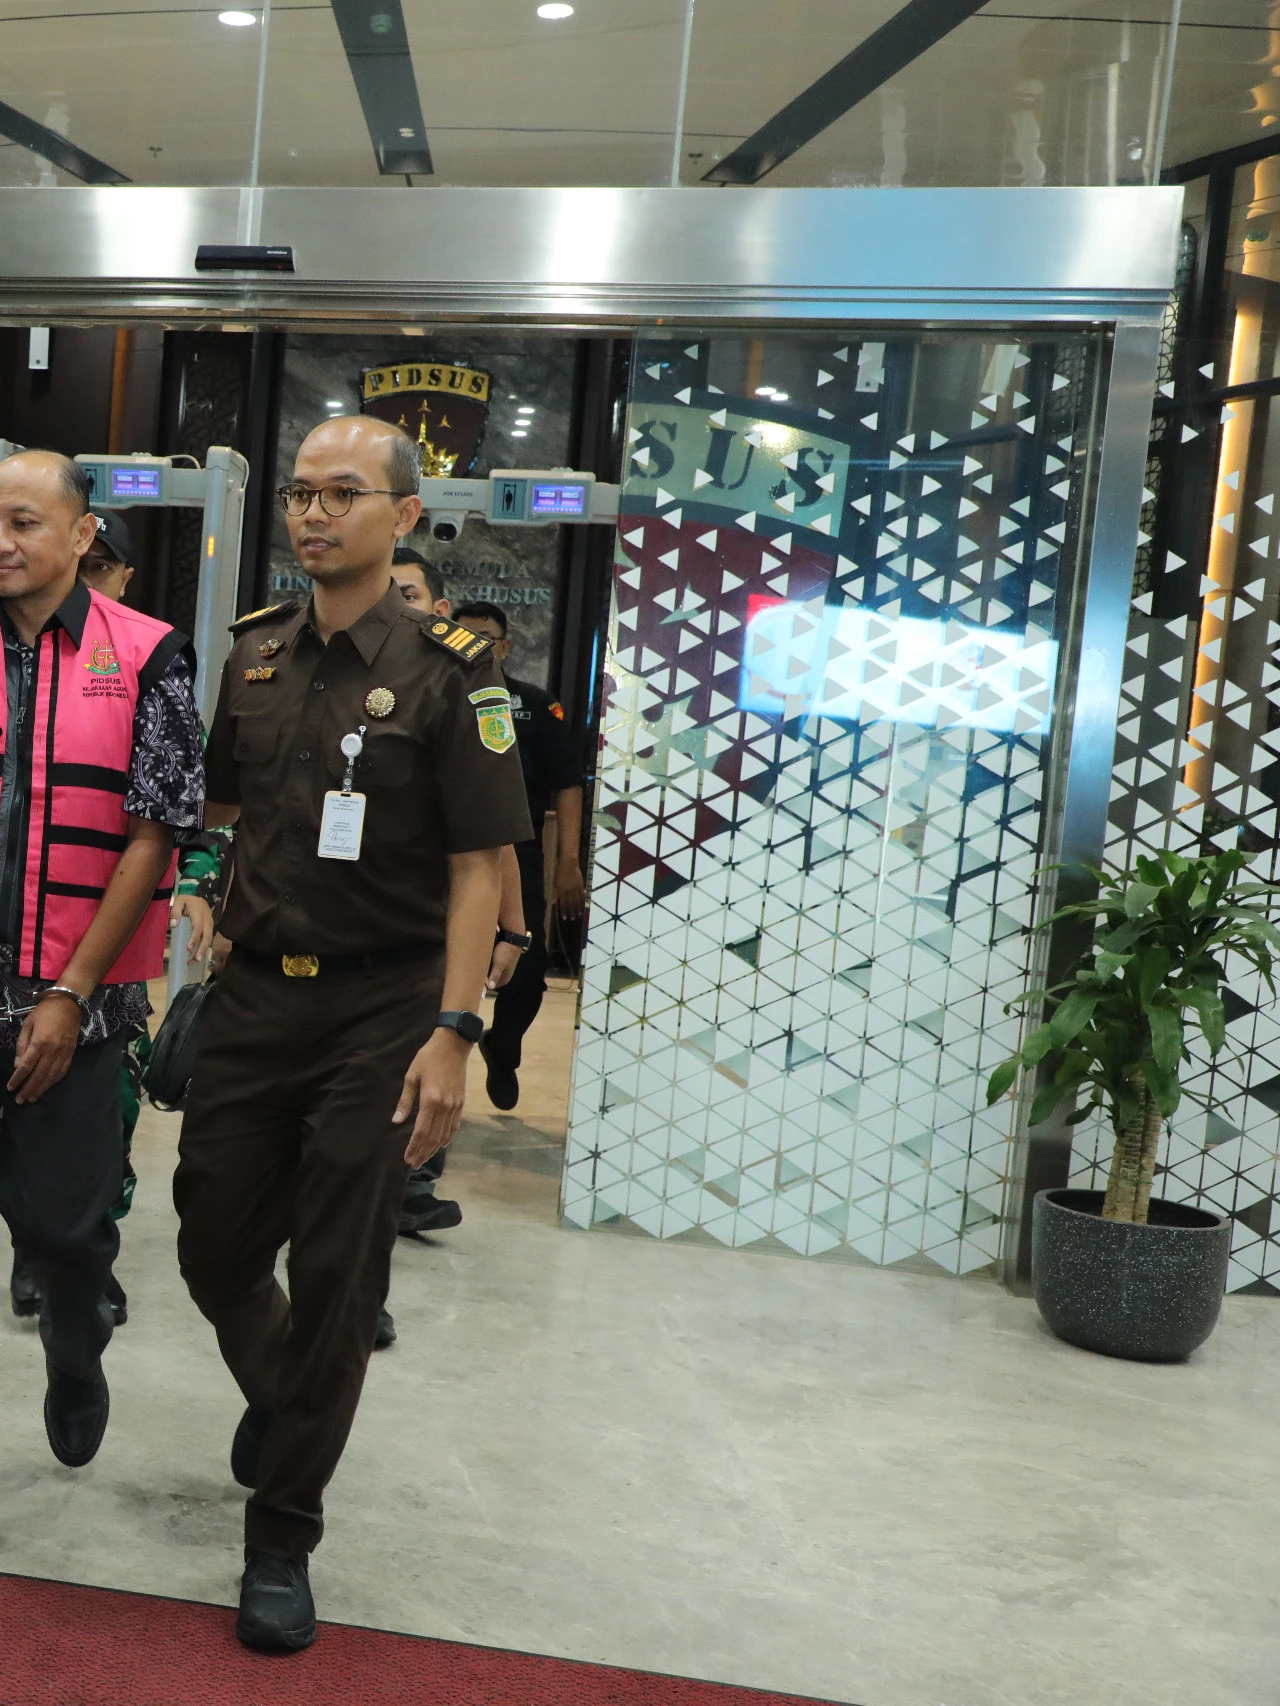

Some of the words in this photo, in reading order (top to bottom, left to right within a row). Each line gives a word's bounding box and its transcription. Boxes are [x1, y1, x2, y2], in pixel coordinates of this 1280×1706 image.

[369, 368, 486, 394] PIDSUS
[465, 639, 489, 658] JAKSA
[91, 677, 121, 685] PIDSUS
